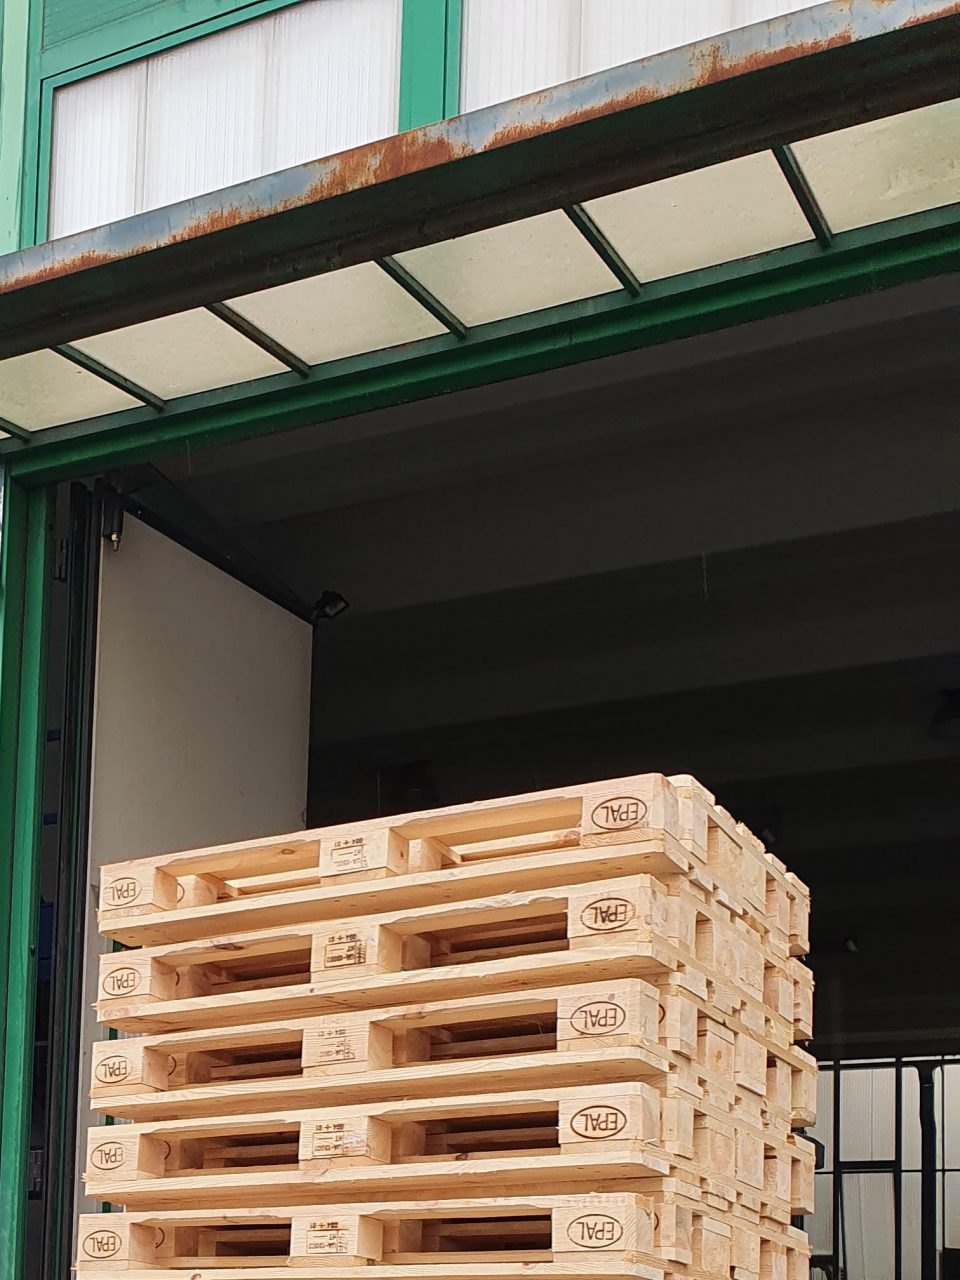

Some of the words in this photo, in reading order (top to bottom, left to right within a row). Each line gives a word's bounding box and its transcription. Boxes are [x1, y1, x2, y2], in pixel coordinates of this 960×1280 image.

[600, 802, 639, 824] EPAL
[109, 881, 136, 901] EPAL
[589, 903, 628, 924] EPAL
[109, 972, 136, 991] EPAL
[580, 1007, 617, 1029] EPAL
[101, 1060, 127, 1078] EPAL
[579, 1112, 618, 1132] EPAL
[97, 1147, 124, 1165] EPAL
[576, 1221, 615, 1241] EPAL
[89, 1235, 116, 1253] EPAL
